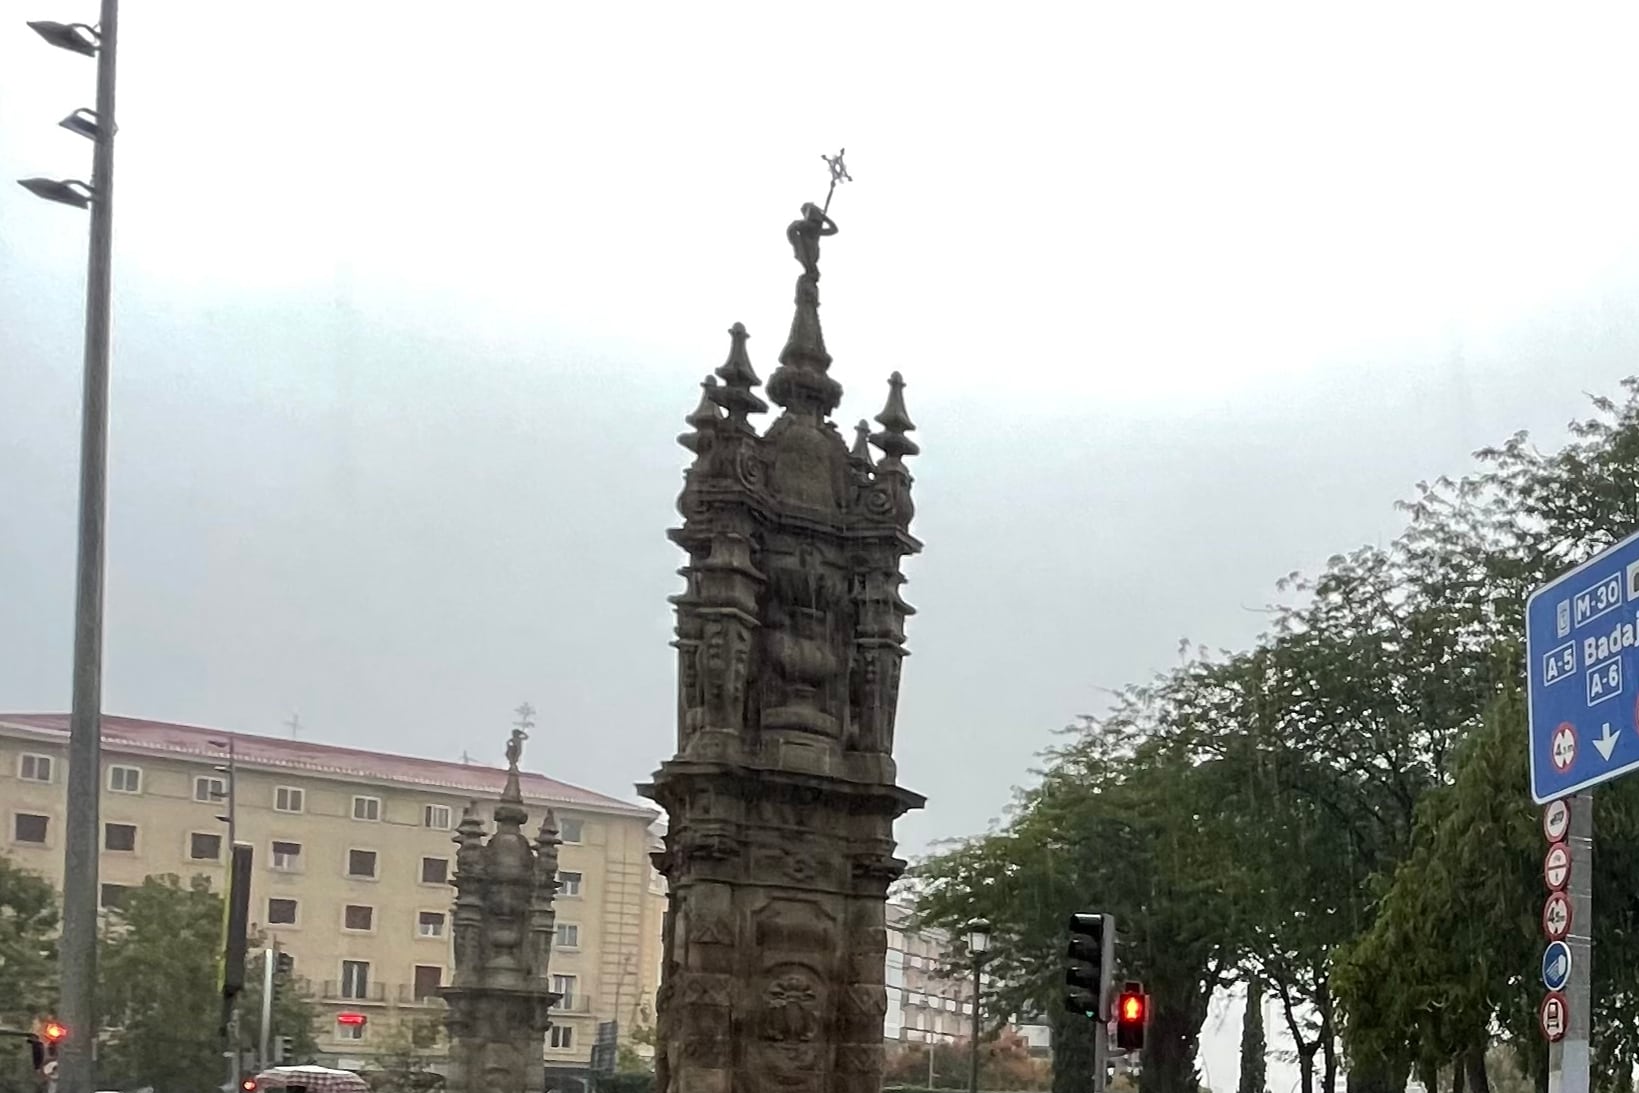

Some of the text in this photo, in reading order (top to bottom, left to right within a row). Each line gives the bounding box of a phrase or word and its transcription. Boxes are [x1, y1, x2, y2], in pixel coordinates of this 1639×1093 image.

[1577, 580, 1618, 621] M-30
[1547, 648, 1573, 681] A-5
[1590, 664, 1619, 698] A-6
